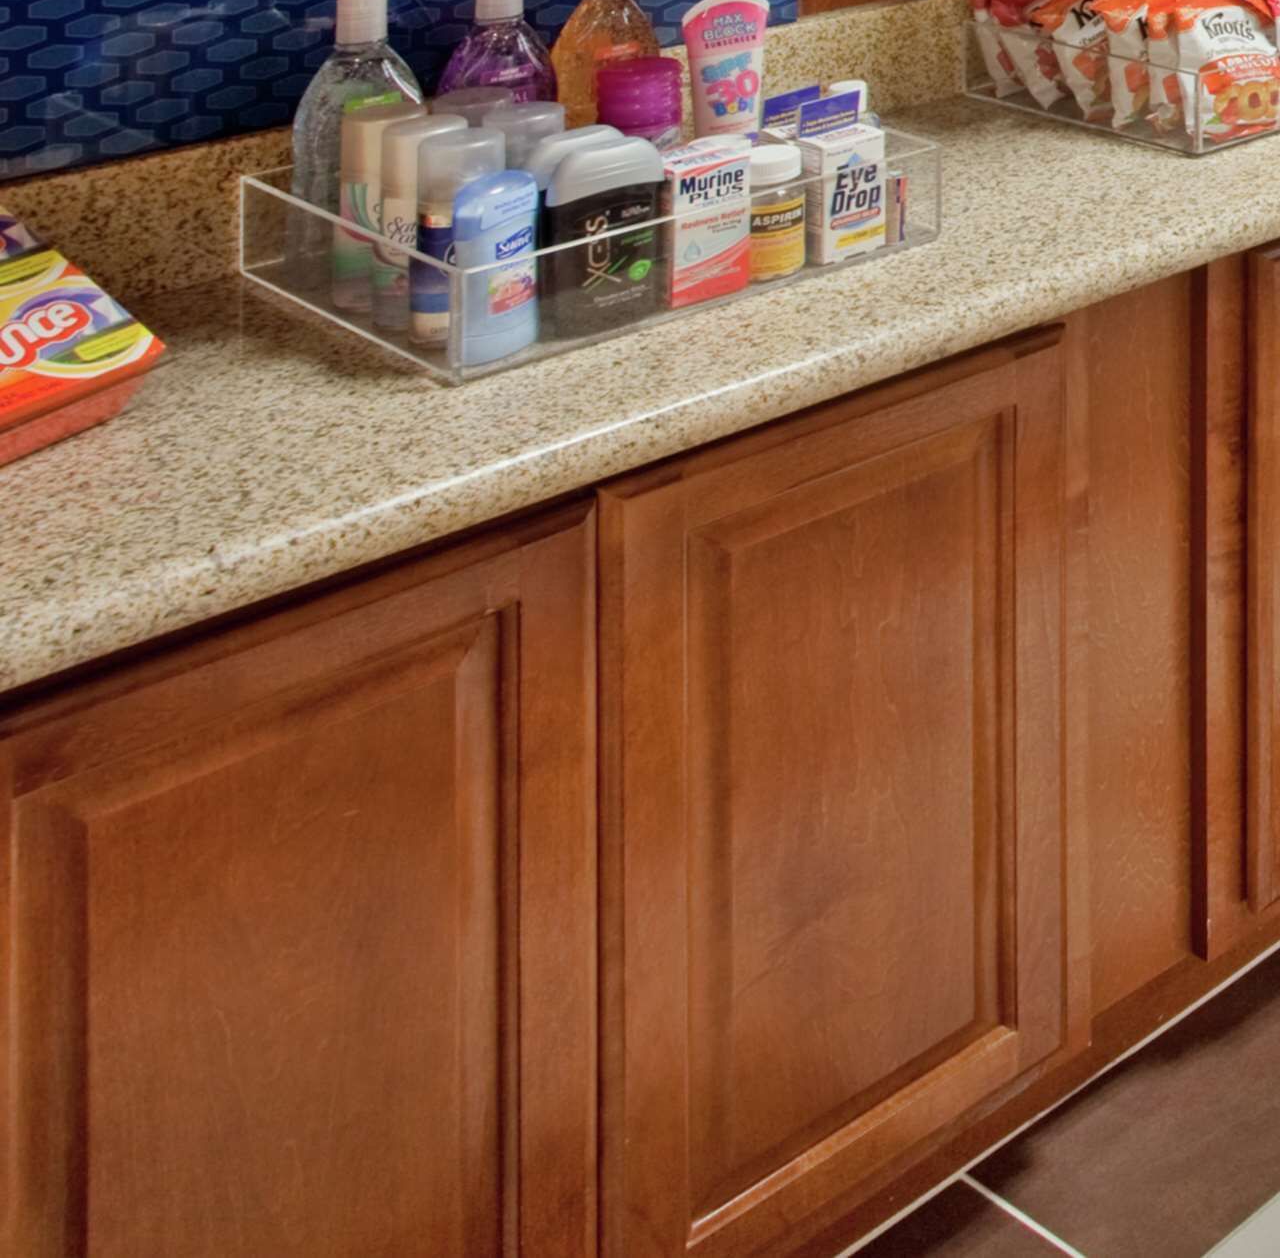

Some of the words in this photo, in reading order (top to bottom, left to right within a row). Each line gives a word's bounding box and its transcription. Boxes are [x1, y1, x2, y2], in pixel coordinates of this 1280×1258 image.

[703, 21, 757, 43] BLOCK
[712, 13, 743, 27] MAX
[1201, 12, 1256, 41] Knott's
[704, 35, 758, 50] SUNSCREEN
[701, 52, 753, 83] SPF
[1216, 52, 1280, 75] APRICOT
[705, 68, 760, 103] 30
[679, 167, 745, 196] Murine
[835, 163, 878, 193] Eye
[688, 183, 745, 205] PLUS
[830, 184, 882, 217] Drop
[681, 213, 719, 231] Redness
[720, 206, 747, 221] Relief
